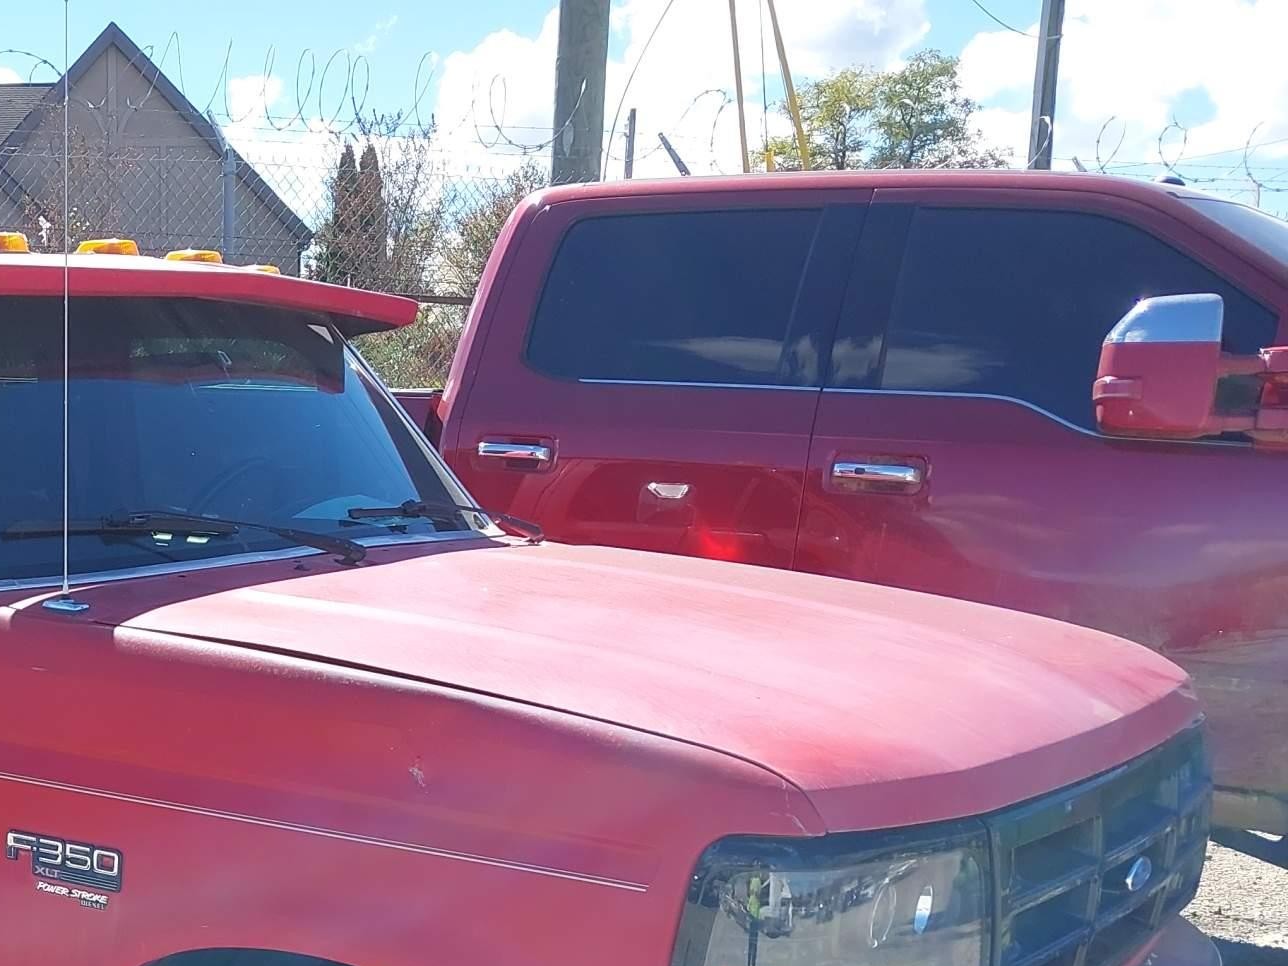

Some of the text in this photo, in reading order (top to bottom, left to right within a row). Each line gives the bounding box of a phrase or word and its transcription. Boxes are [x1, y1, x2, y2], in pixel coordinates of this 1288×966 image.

[35, 866, 60, 879] XLT
[37, 881, 109, 905] POWER STROKE
